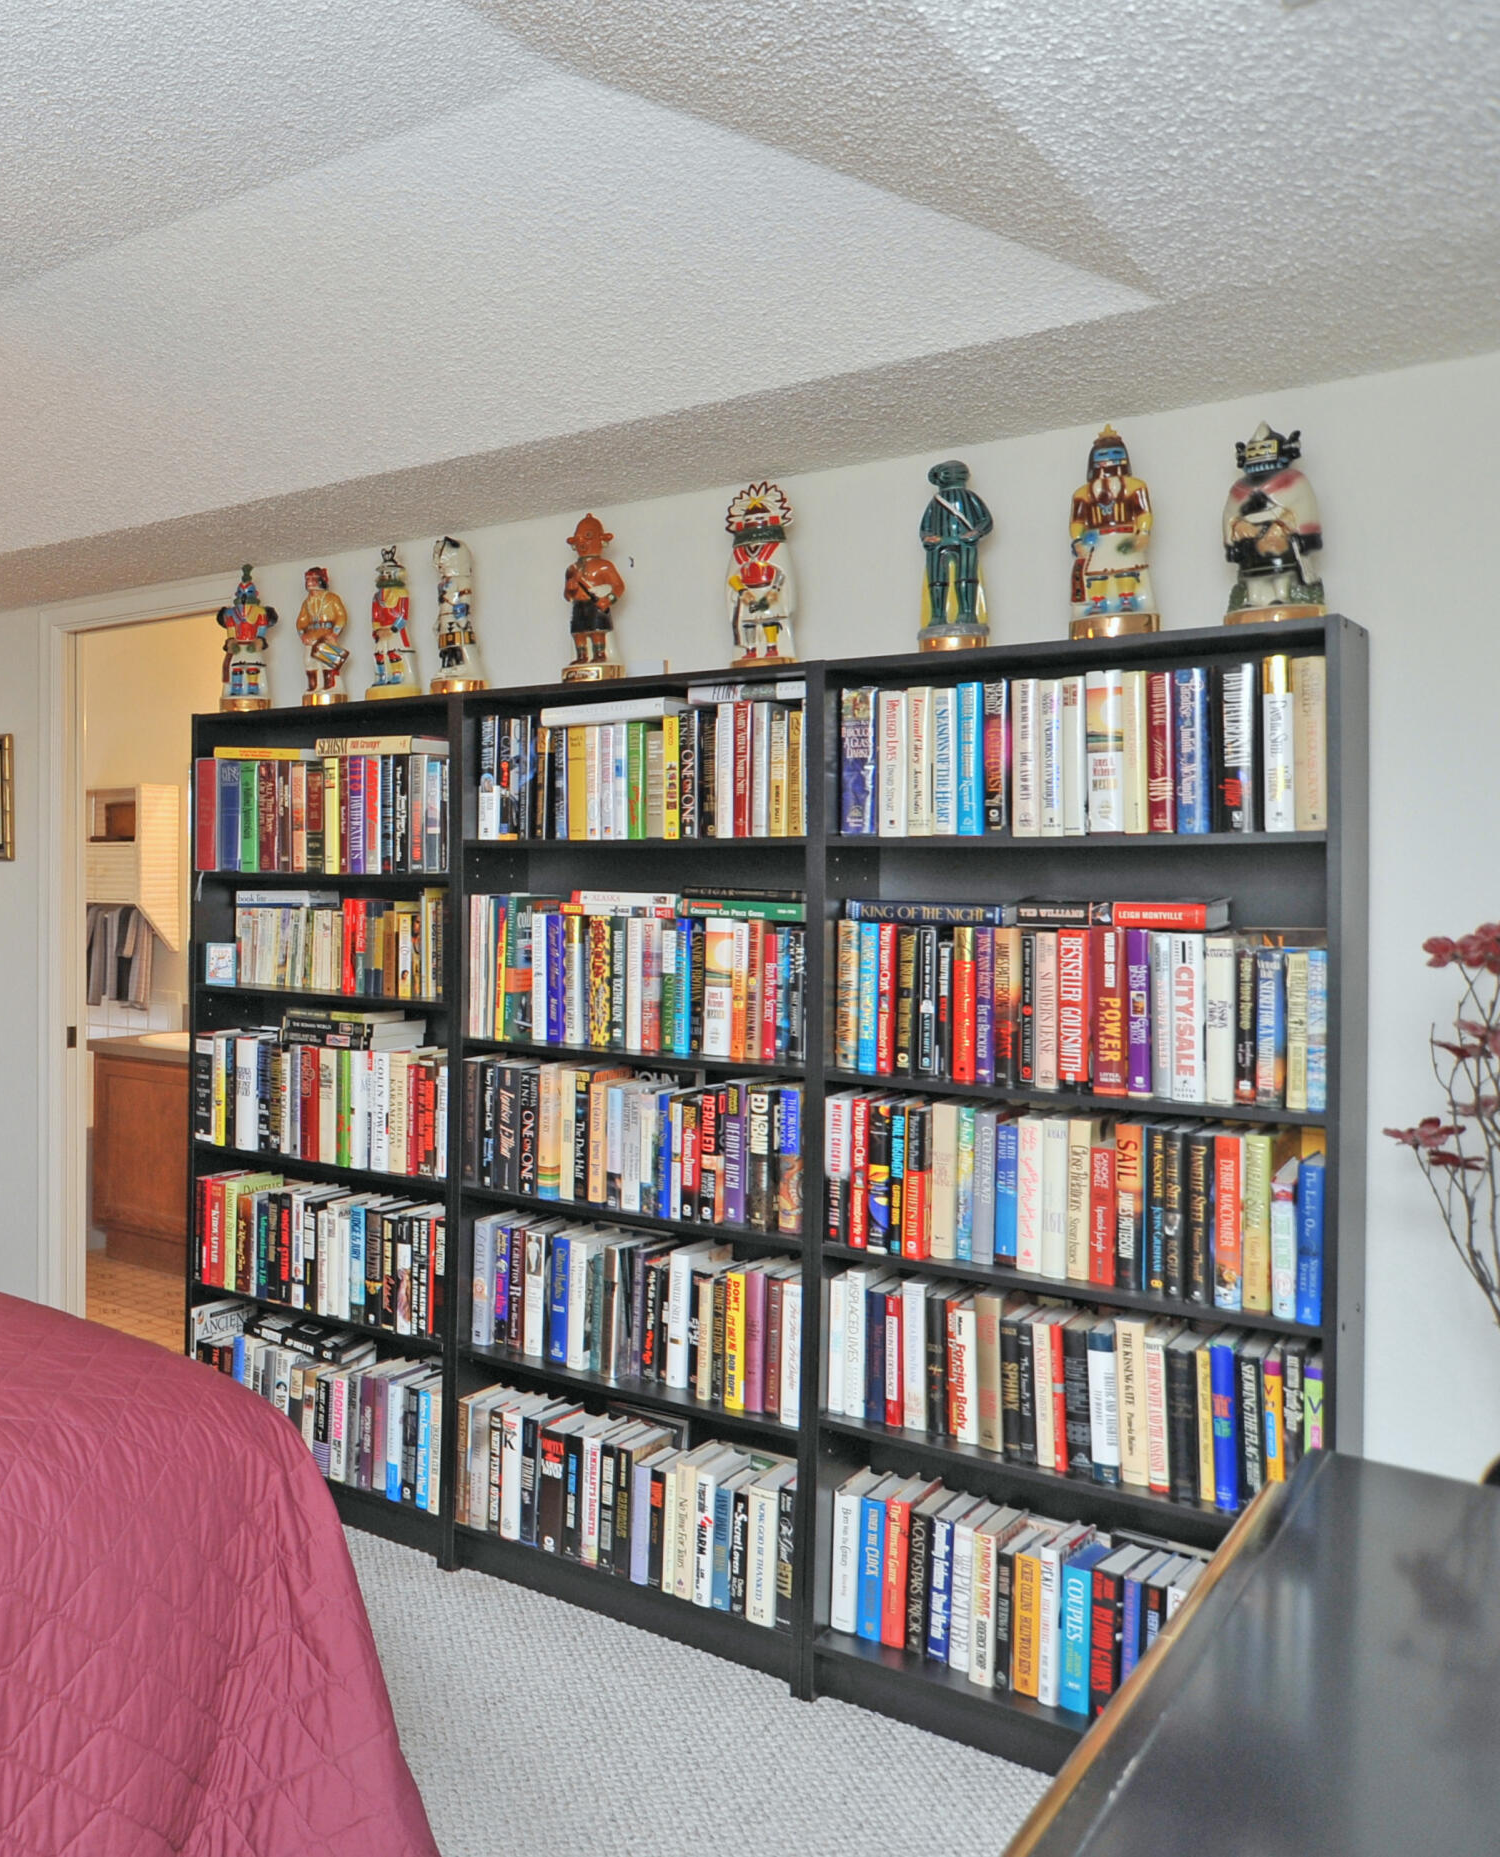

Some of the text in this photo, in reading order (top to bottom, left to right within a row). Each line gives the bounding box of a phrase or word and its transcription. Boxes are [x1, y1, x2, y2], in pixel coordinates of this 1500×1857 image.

[482, 748, 493, 769] WIVES
[682, 750, 694, 779] ONE
[935, 709, 952, 823] SEASONS OF THE HEART
[367, 760, 378, 823] MAYDAY
[682, 794, 694, 823] ONE
[508, 901, 516, 930] collector
[861, 905, 985, 921] KING OF THE NIGHT
[1020, 907, 1085, 919] TED WILLIAMS
[1118, 910, 1183, 921] LEIGH MONTVILLE
[506, 946, 514, 966] digest
[736, 929, 744, 968] CHOPPING
[795, 944, 804, 973] JOAN
[665, 976, 674, 1032] QUENTINS
[996, 967, 1010, 1007] PATTERSON
[1060, 938, 1082, 1072] BESTSELLER GOLDSMITH
[1175, 967, 1194, 1014] CITY
[1023, 1018, 1031, 1063] KATE WHITE
[1103, 997, 1121, 1062] POWER
[1175, 1022, 1194, 1076] SALE
[521, 1075, 529, 1106] KING
[530, 1076, 538, 1106] TABITHA
[751, 1094, 768, 1113] ED
[375, 1105, 384, 1150] POWELL
[703, 1095, 714, 1152] DERAILED
[831, 1104, 842, 1134] MICHAEL
[522, 1111, 534, 1179] ONE ON ONE
[575, 1121, 585, 1179] The Dark Half
[726, 1122, 739, 1188] DEADLY RICH
[831, 1138, 841, 1172] CRICHTON
[891, 1116, 905, 1178] FINAL ARGUMENT
[981, 1156, 992, 1173] THE
[1070, 1145, 1089, 1170] Close
[1117, 1139, 1138, 1181] SAIL
[706, 1173, 715, 1198] JAMES
[1093, 1154, 1102, 1187] BUSHNELL
[1101, 1153, 1109, 1189] CANDACE
[1153, 1135, 1163, 1198] THE ASSOCIATE
[907, 1176, 918, 1218] MOTHER'S
[980, 1175, 991, 1204] NOVEL
[1069, 1172, 1088, 1212] Relations
[1167, 1183, 1181, 1208] STEEL
[1220, 1160, 1235, 1246] DEBBIE MACOMBER
[1303, 1172, 1316, 1236] The Lucky One
[352, 1210, 360, 1235] JUDGE
[412, 1222, 420, 1251] RHODES
[829, 1208, 839, 1226] FEAR
[907, 1221, 917, 1236] DAY
[1119, 1191, 1134, 1259] JAMES PATTERSON
[352, 1243, 360, 1260] JURY
[420, 1221, 428, 1254] RICHARD
[1091, 1232, 1107, 1252] Jungle
[1151, 1207, 1163, 1271] JOHN GRISHAM
[554, 1248, 566, 1298] Citizen Hughes
[1168, 1240, 1178, 1278] ROGUE
[1300, 1263, 1308, 1291] SPARKS
[1309, 1259, 1318, 1298] NICHOLAS
[411, 1263, 420, 1334] THE ATOMIC BOMB
[418, 1269, 427, 1330] THE MAKING OF
[732, 1281, 741, 1312] DON'T
[713, 1285, 723, 1353] SIDNEY SHELDON
[848, 1275, 859, 1363] MISPLACED LIVES
[727, 1354, 736, 1396] BOB HOPE
[955, 1344, 967, 1429] Foreign Body
[1003, 1362, 1019, 1411] SPHINX
[1122, 1333, 1135, 1406] THE KISSING GATE
[317, 1405, 325, 1413] AT
[334, 1380, 343, 1439] DEIGHTON
[1241, 1362, 1259, 1461] SHOWING THE FLAG
[678, 1512, 688, 1531] Time
[679, 1498, 688, 1511] No
[678, 1533, 687, 1546] For
[734, 1513, 747, 1546] Secret
[865, 1509, 878, 1577] UNDER THE CLOCK
[889, 1505, 902, 1585] The Ultimate Game
[733, 1548, 743, 1574] Lovers
[755, 1503, 766, 1600] NOW GOD BE THANKED
[951, 1574, 970, 1652] PICTURE
[1066, 1578, 1084, 1643] COUPLES
[1093, 1605, 1114, 1650] BLOOD
